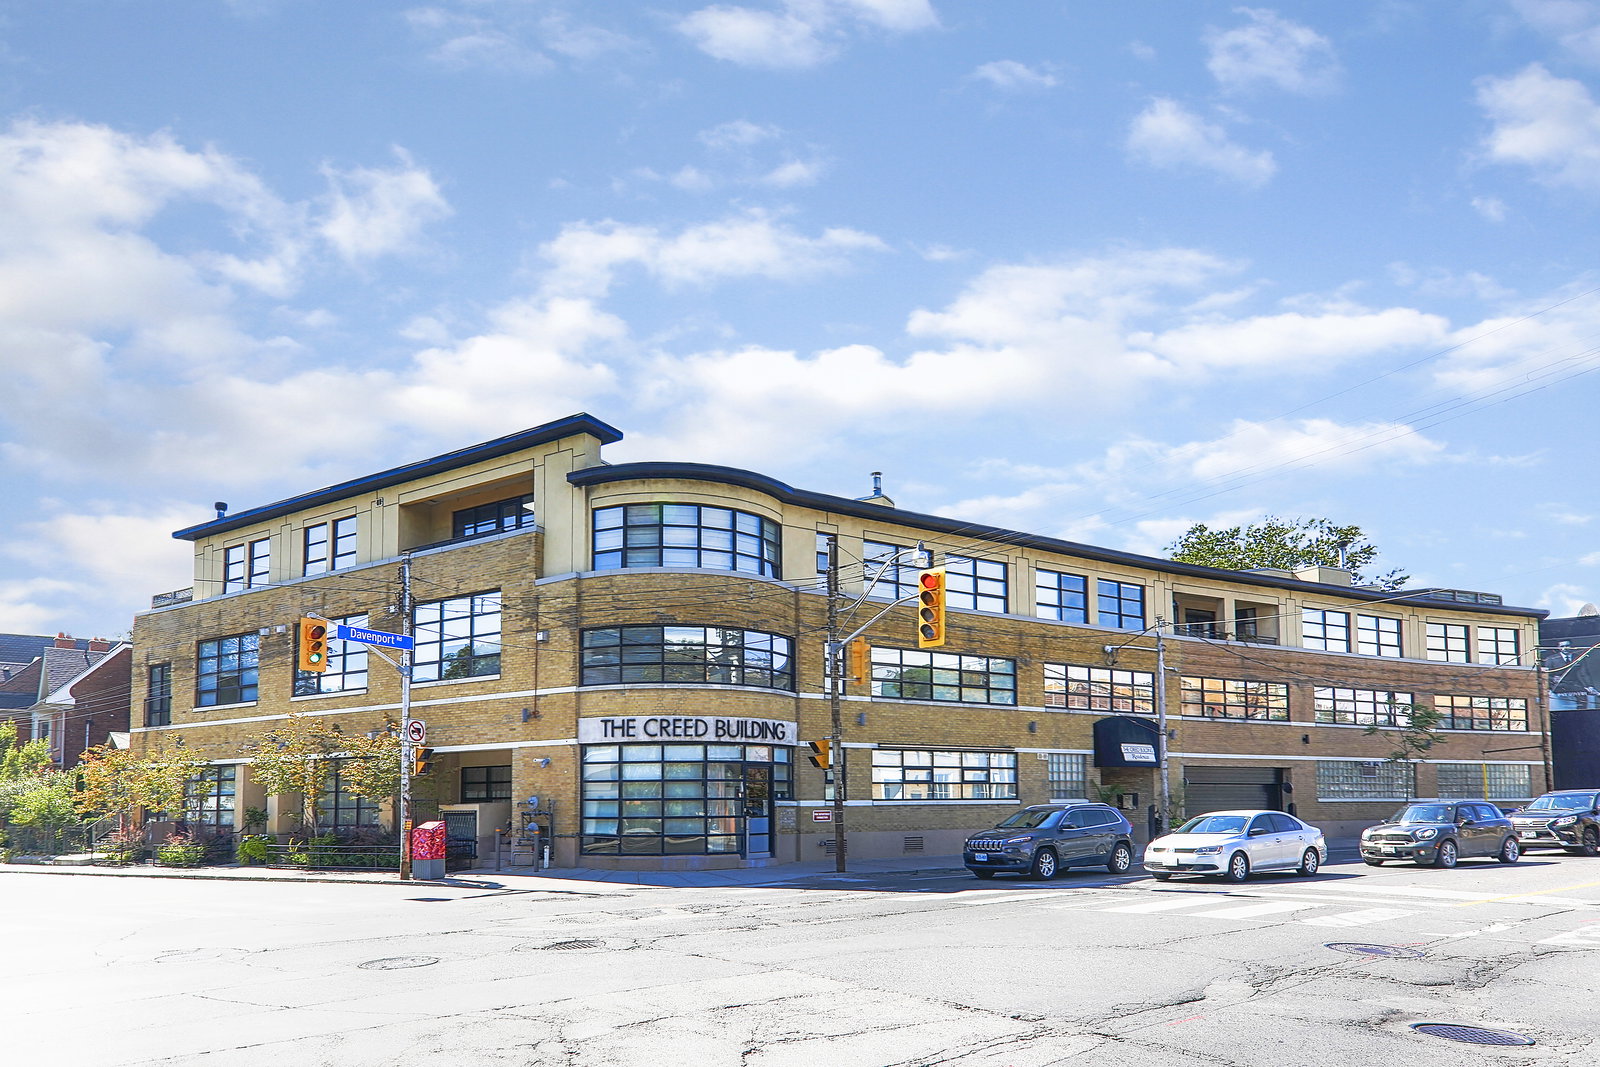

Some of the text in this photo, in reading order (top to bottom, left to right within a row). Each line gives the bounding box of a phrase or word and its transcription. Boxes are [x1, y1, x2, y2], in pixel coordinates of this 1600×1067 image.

[350, 628, 395, 645] Davenport
[600, 718, 786, 740] THE CREED BUILDING
